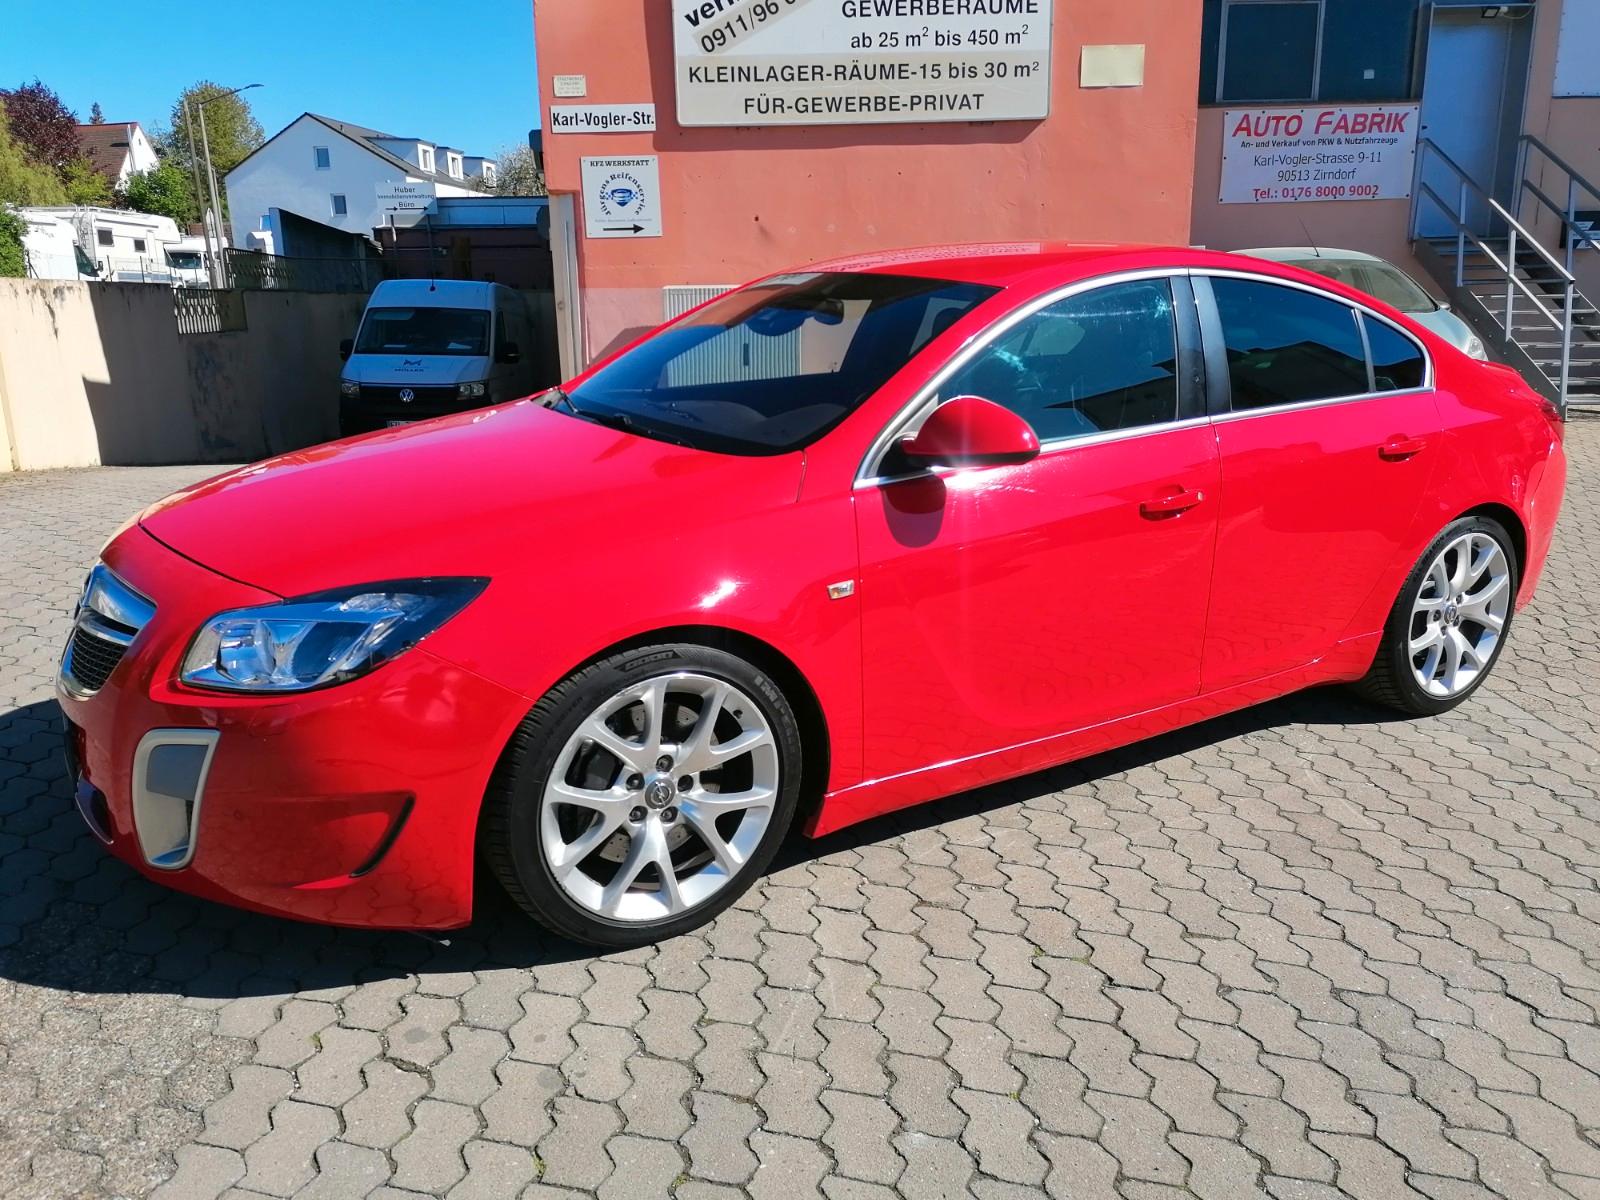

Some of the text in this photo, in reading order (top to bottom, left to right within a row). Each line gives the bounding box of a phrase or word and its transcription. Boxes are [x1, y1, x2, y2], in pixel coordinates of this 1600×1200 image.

[850, 32, 873, 48] ab
[878, 32, 899, 48] 25
[934, 30, 962, 46] bis
[967, 29, 999, 45] 450
[948, 63, 978, 79] bis
[984, 62, 1007, 78] 30
[744, 93, 985, 114] FÜR-GEWERBE-PRIVAT
[552, 112, 655, 128] Karl-Vogler-Str.
[1231, 110, 1410, 138] AUTO FABRIK
[1241, 140, 1254, 148] An-
[1255, 140, 1270, 148] und
[1272, 139, 1301, 147] Verkauf
[1302, 139, 1316, 147] von
[1317, 138, 1335, 146] PKW
[1345, 137, 1399, 146] Nutzfahrzeuge
[605, 159, 650, 167] WERKSTATT
[1254, 151, 1382, 168] Karl-Vogler-Strasse 9-11
[1277, 168, 1357, 182] 90513 Zirndorf
[1253, 184, 1379, 199] Tel.: 0176 8000 9002
